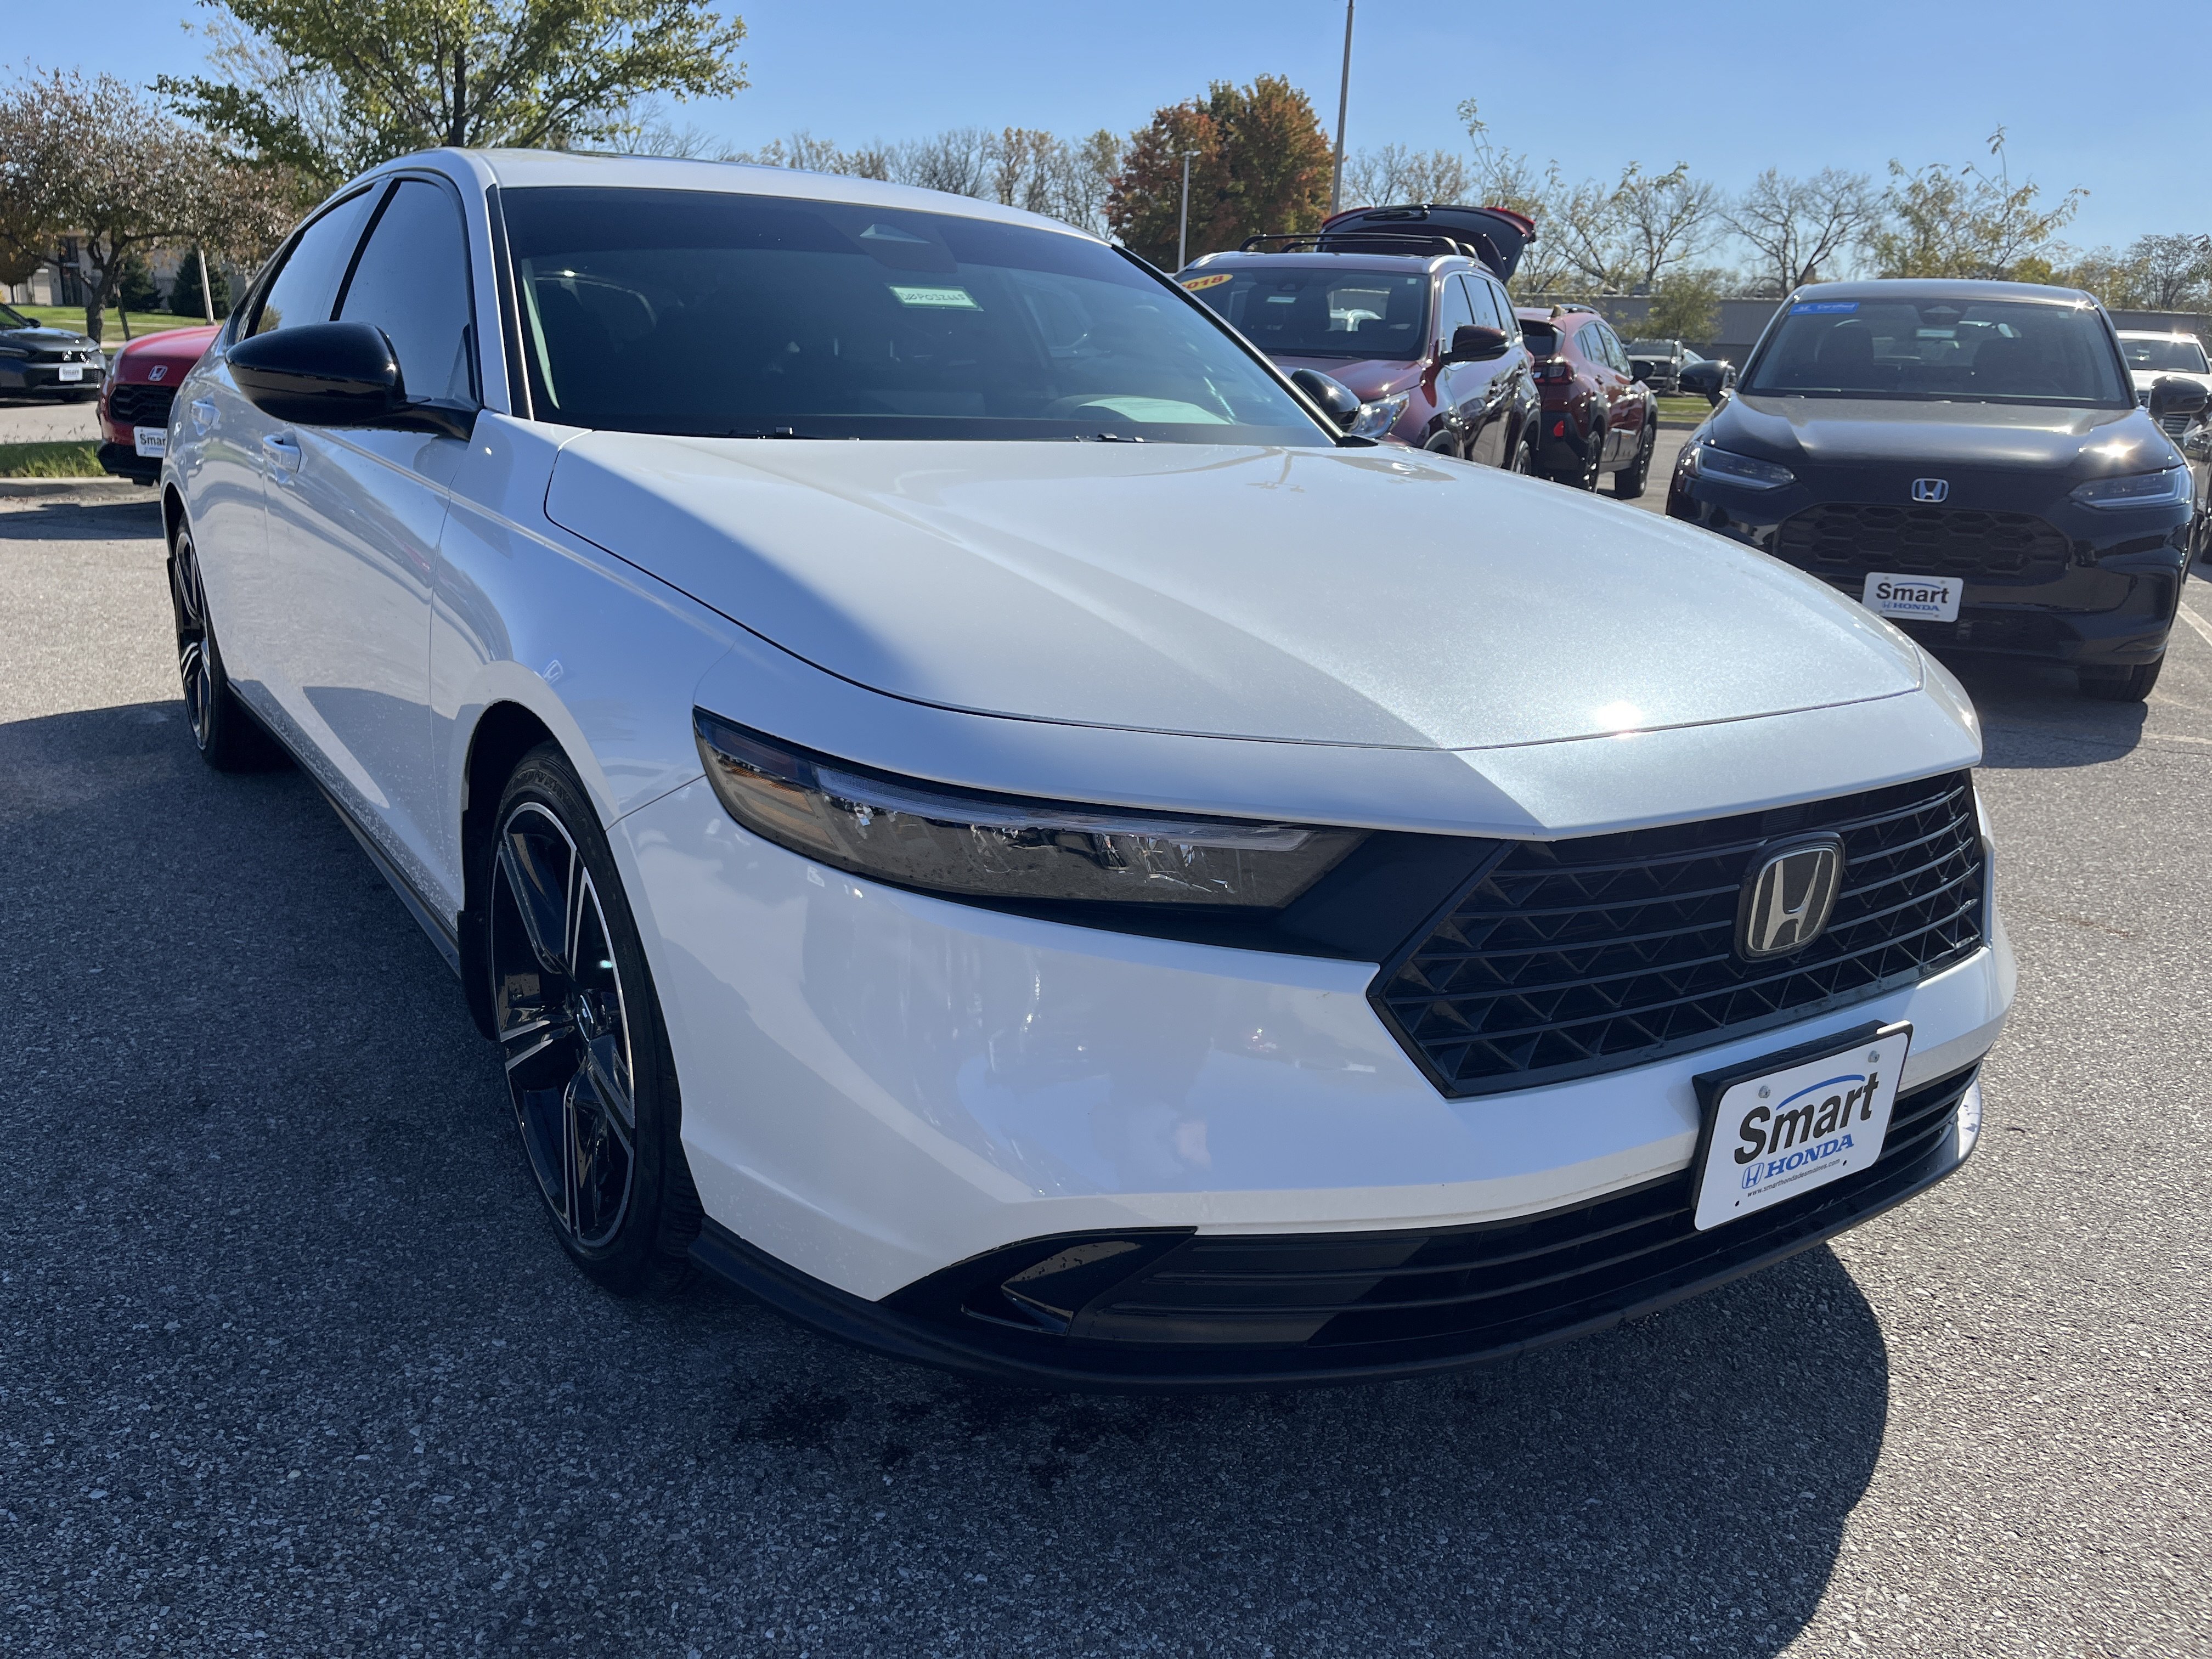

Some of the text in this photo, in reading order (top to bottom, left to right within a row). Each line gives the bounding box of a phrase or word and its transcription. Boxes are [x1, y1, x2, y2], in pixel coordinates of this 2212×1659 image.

[140, 433, 166, 445] Smar
[1876, 583, 1949, 603] Smart
[1894, 603, 1940, 611] HONDA
[1734, 1072, 1879, 1164] Smart
[1764, 1133, 1854, 1179] HONDA
[1747, 1159, 1840, 1198] www.smarthondadesmoines.com
